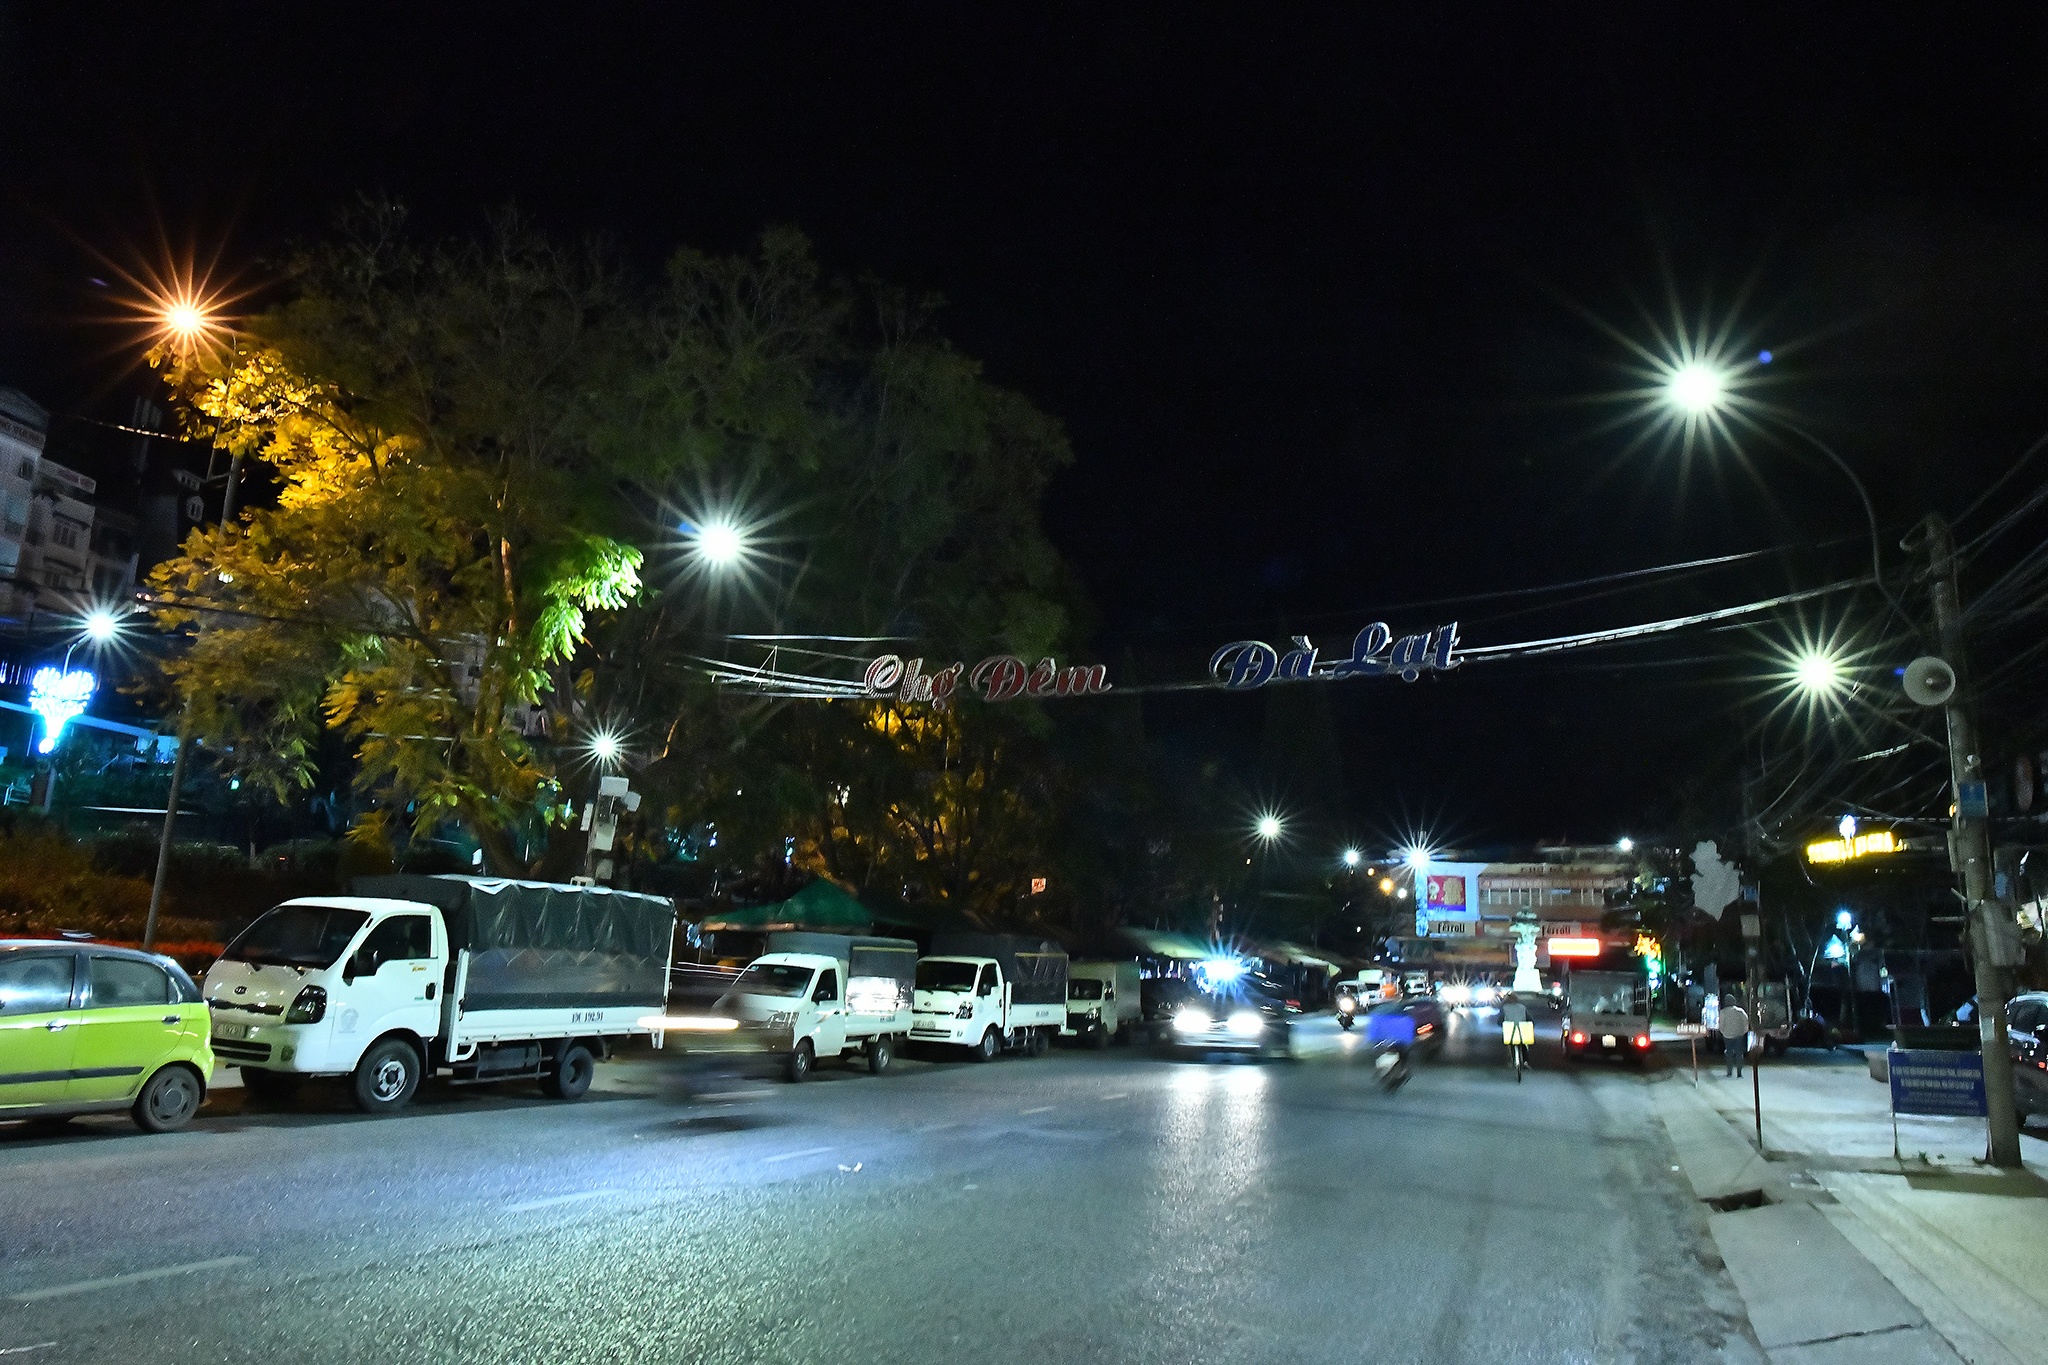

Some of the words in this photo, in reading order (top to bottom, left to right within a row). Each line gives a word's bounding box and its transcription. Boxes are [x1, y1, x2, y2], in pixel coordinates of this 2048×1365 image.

[864, 653, 965, 711] Chợ
[969, 654, 1113, 701] Đêm
[1209, 634, 1320, 690] Đà
[1319, 620, 1466, 683] Lạt
